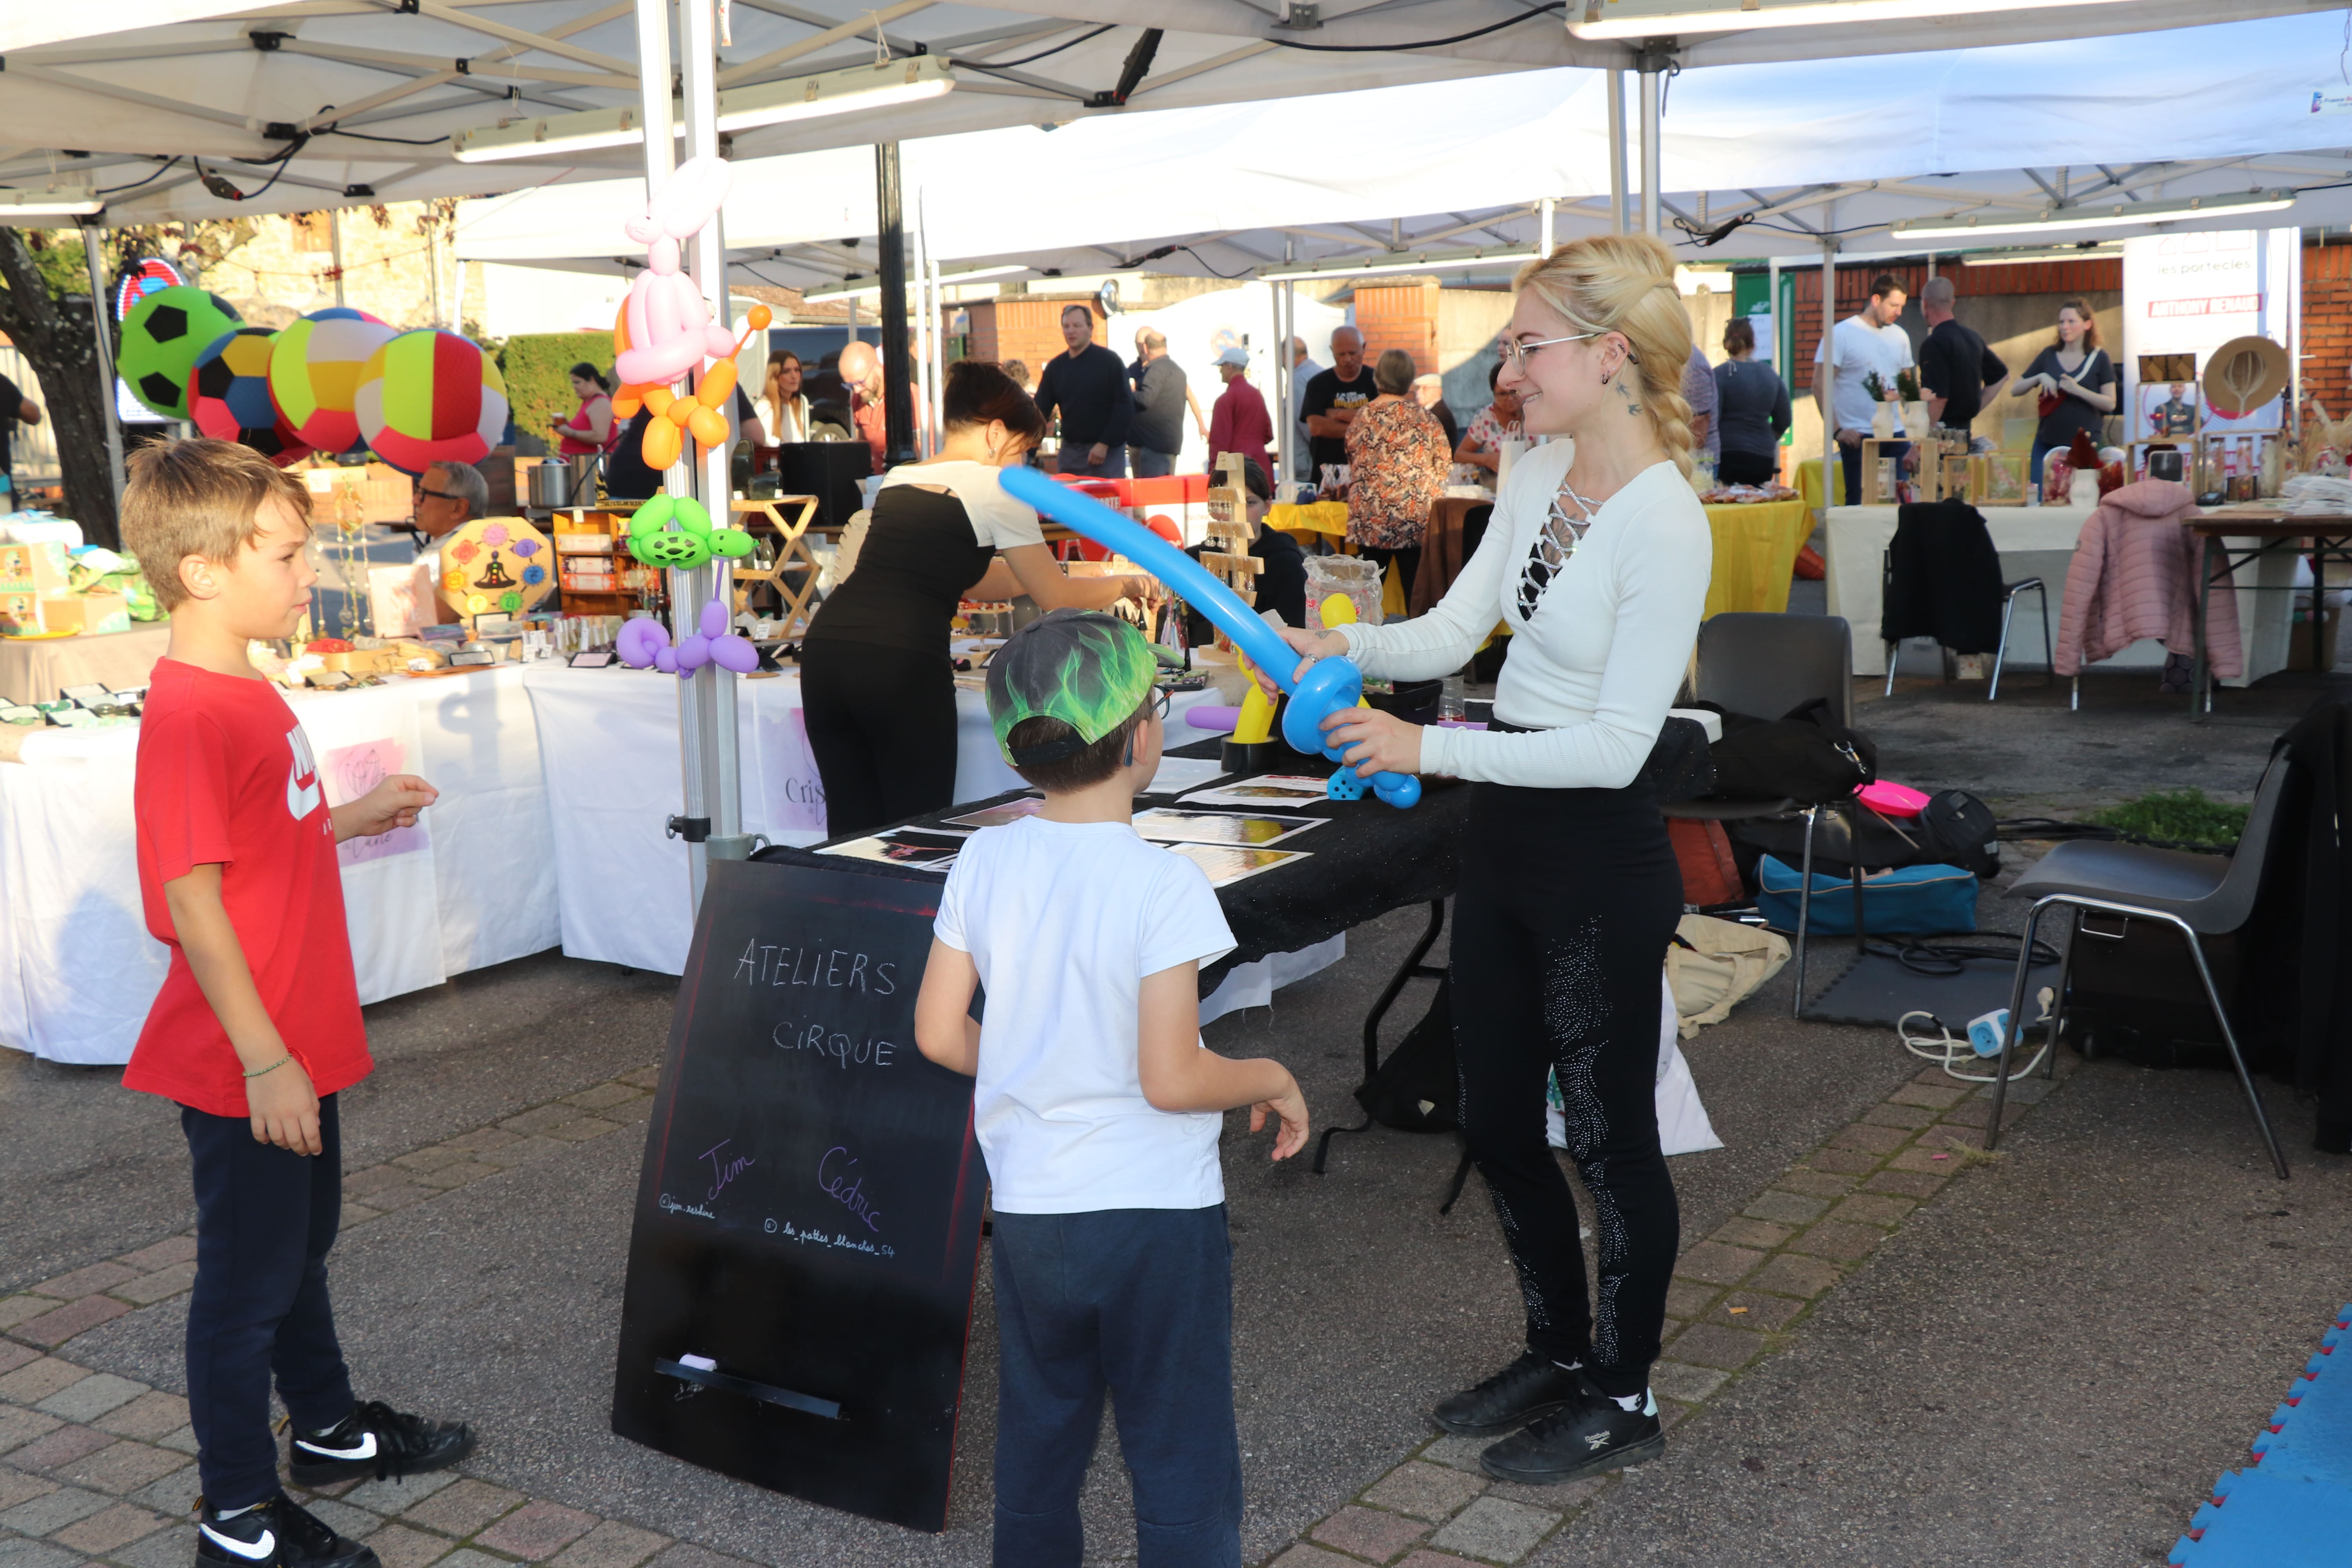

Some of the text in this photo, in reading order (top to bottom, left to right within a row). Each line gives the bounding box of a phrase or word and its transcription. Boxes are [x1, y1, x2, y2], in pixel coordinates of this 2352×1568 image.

[2158, 265, 2177, 274] les
[2151, 299, 2209, 317] ANTHONY
[698, 1139, 755, 1200] Jim
[818, 1147, 880, 1232] Cédric
[1584, 1430, 1610, 1443] Reebok
